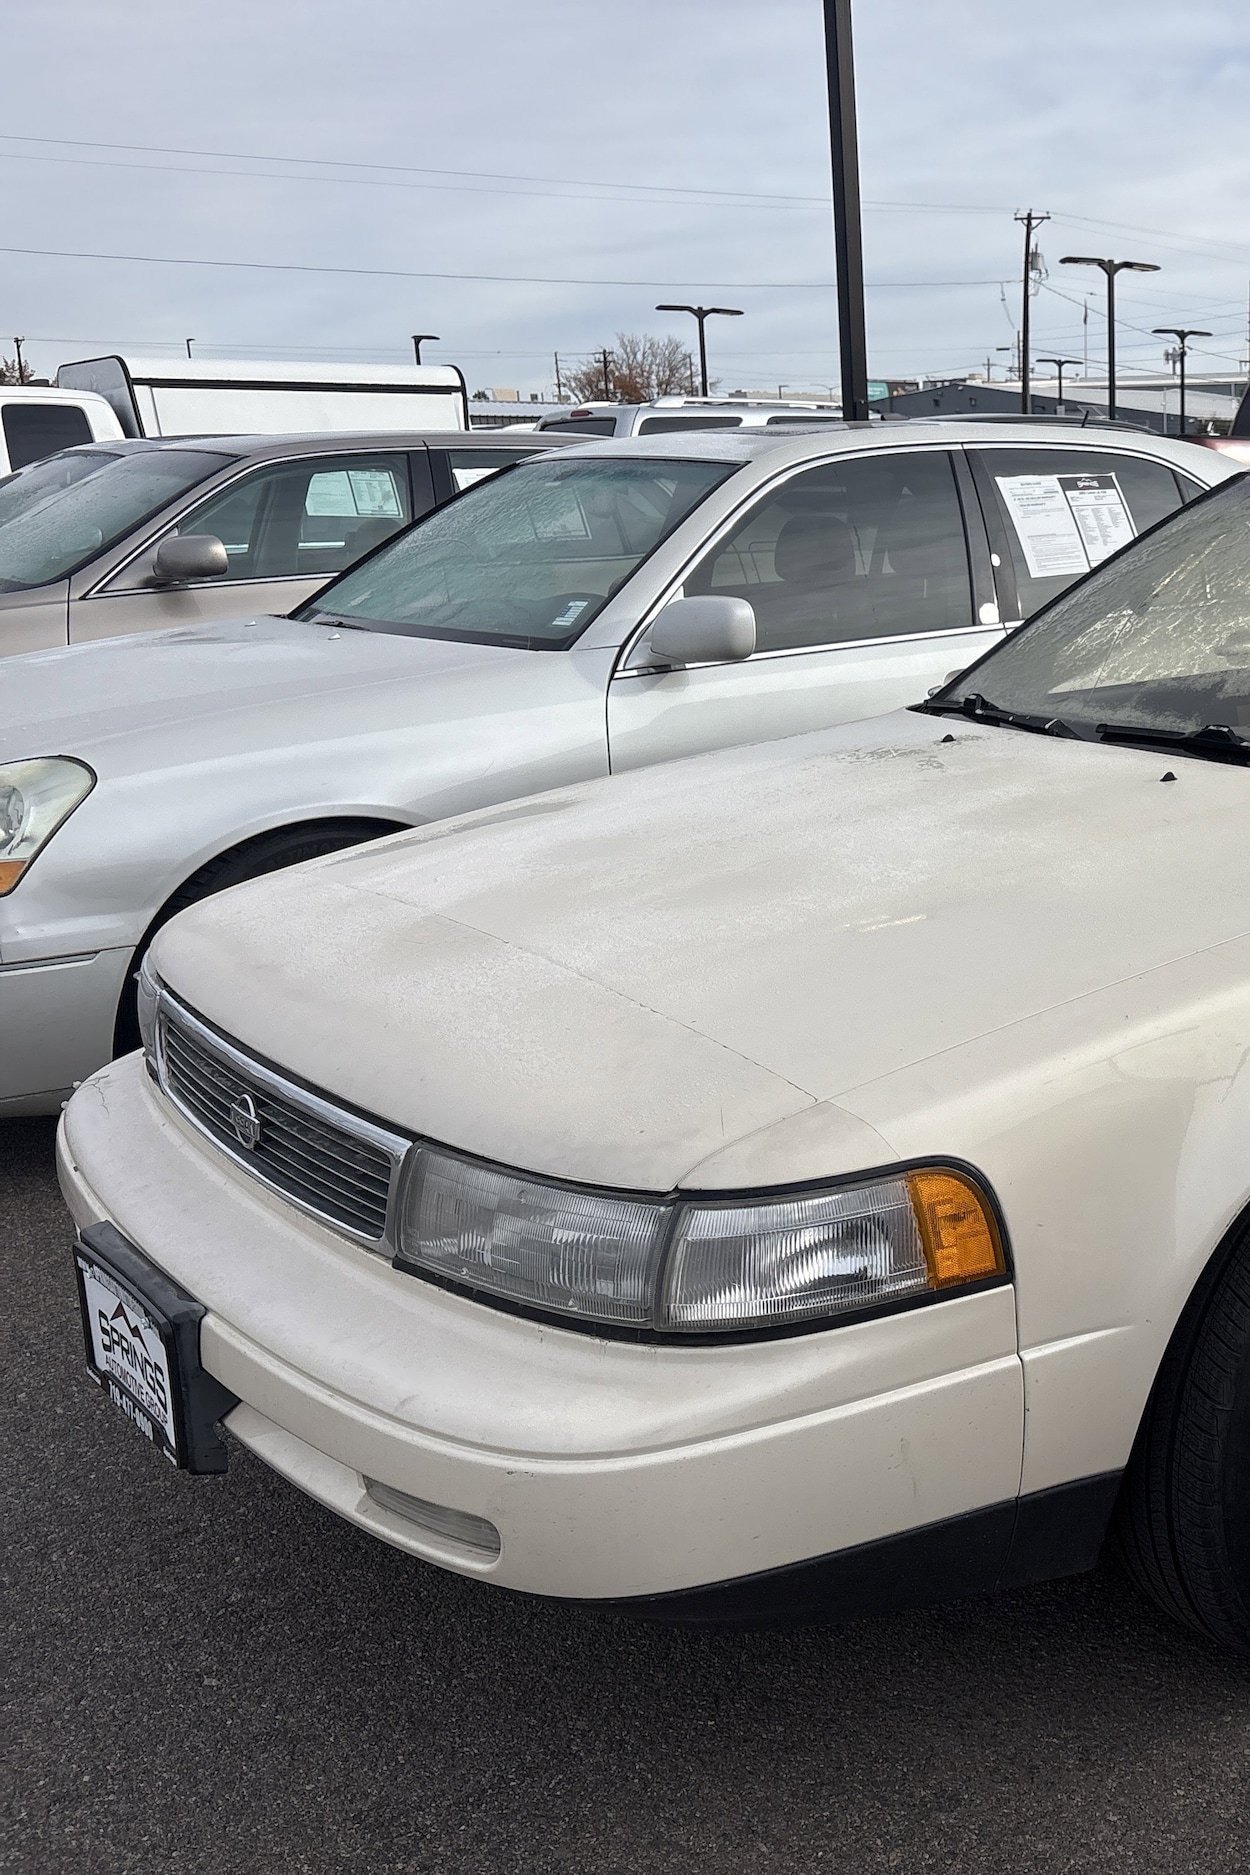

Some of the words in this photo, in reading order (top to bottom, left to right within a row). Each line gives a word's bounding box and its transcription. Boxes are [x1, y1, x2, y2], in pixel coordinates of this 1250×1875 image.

[98, 1308, 168, 1411] SPRINGS
[105, 1355, 145, 1402] AUTOMOTIVE
[146, 1391, 168, 1426] GROUP
